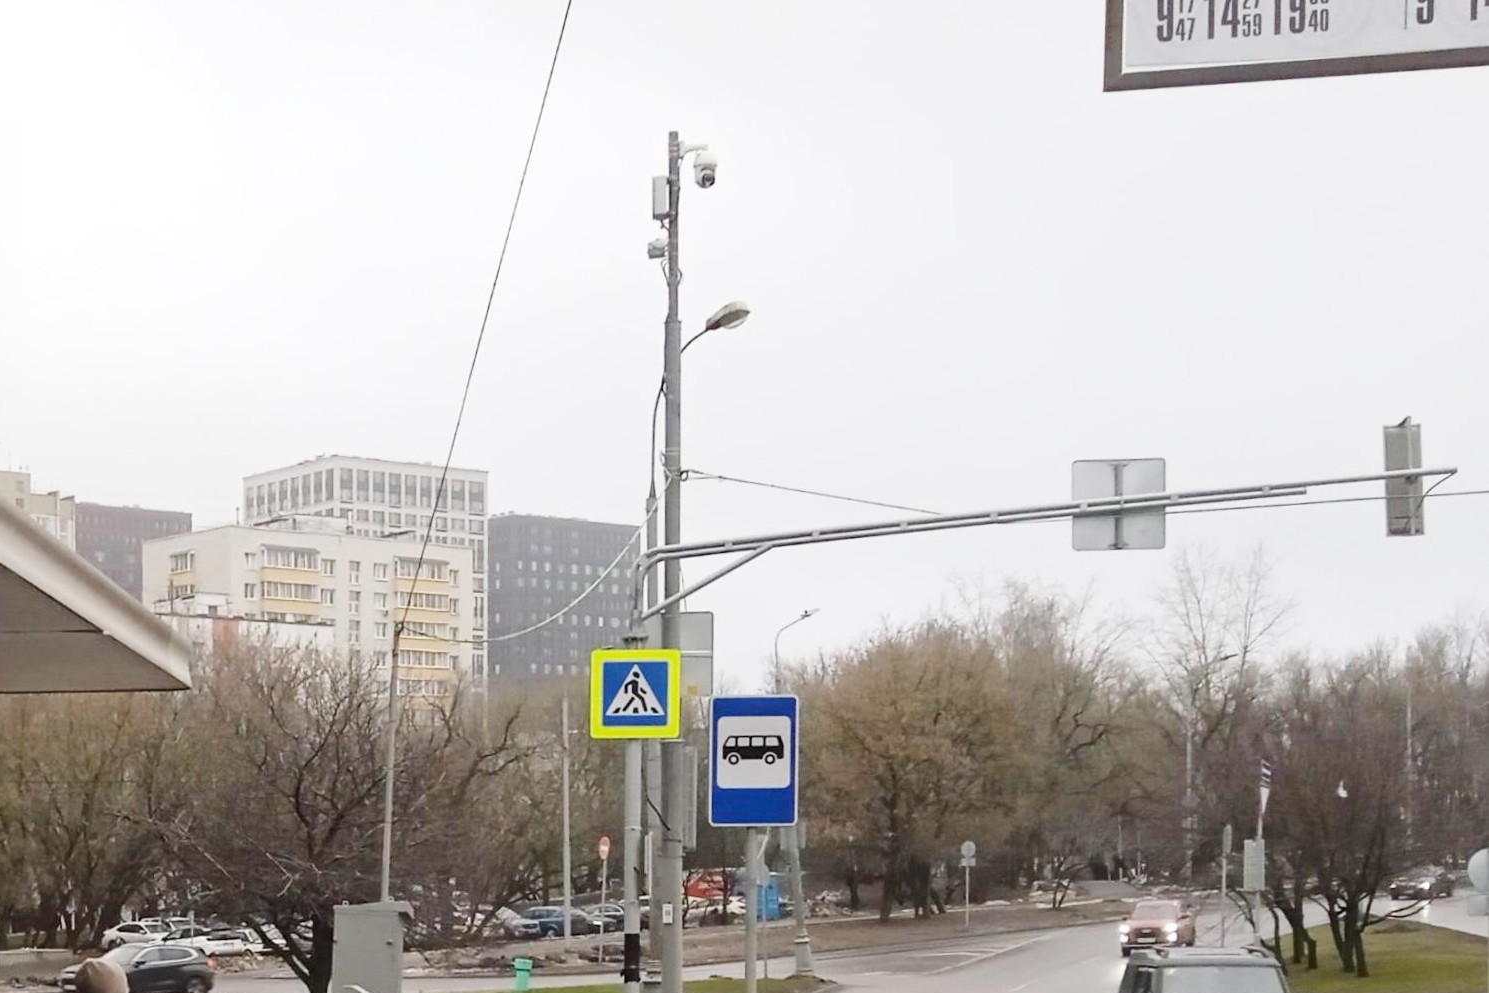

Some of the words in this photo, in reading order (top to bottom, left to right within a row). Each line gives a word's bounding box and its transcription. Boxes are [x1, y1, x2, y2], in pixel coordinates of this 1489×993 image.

[1175, 17, 1196, 41] 47
[1242, 13, 1262, 37] 59
[1308, 9, 1329, 33] 40
